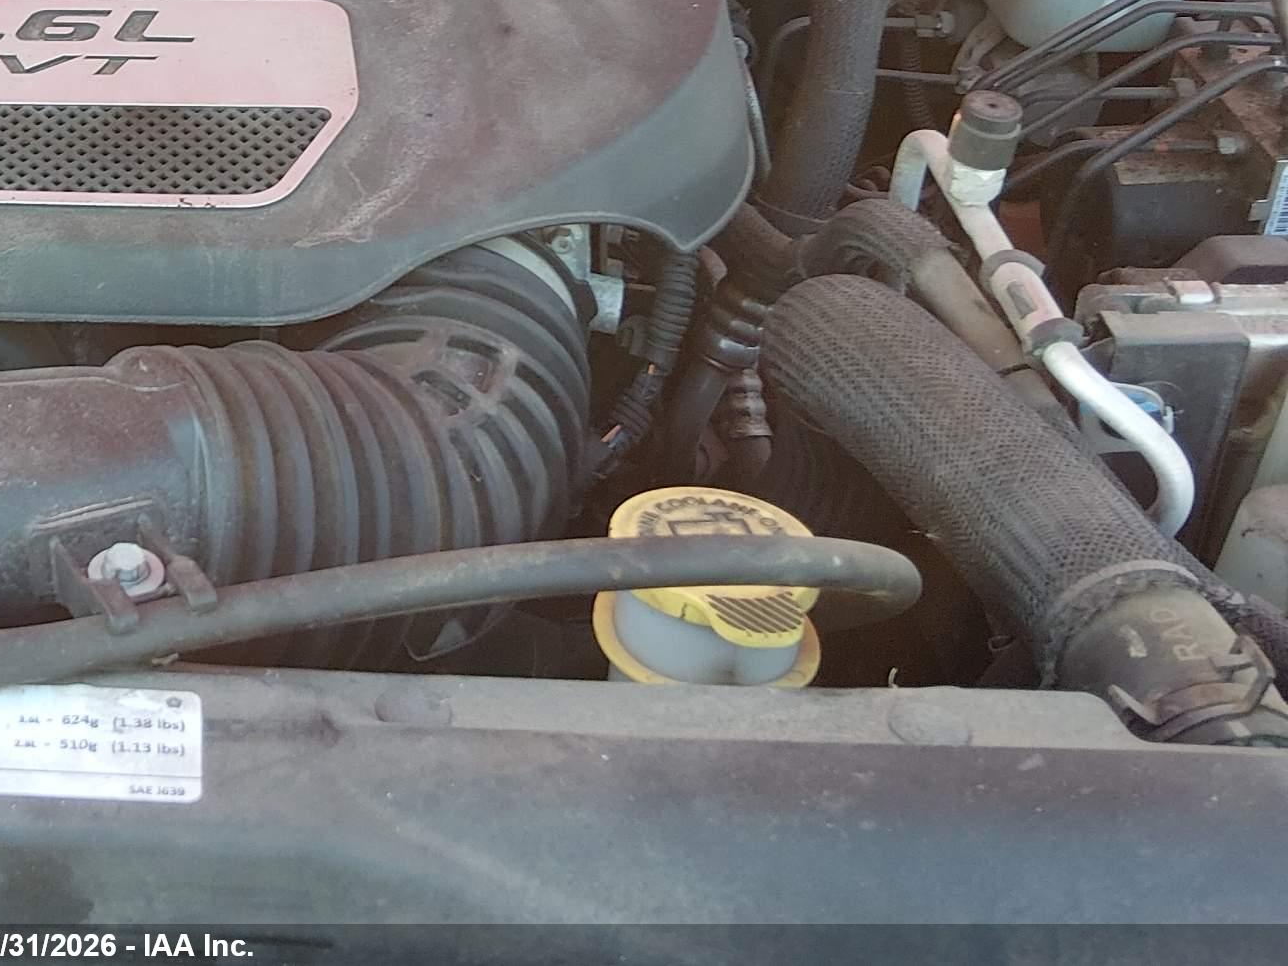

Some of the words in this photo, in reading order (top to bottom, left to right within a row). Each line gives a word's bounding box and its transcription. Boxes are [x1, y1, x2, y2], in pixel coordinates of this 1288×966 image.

[1149, 608, 1206, 663] RAD
[61, 714, 100, 729] 624g
[59, 739, 98, 753] 510g
[127, 785, 154, 795] SAE
